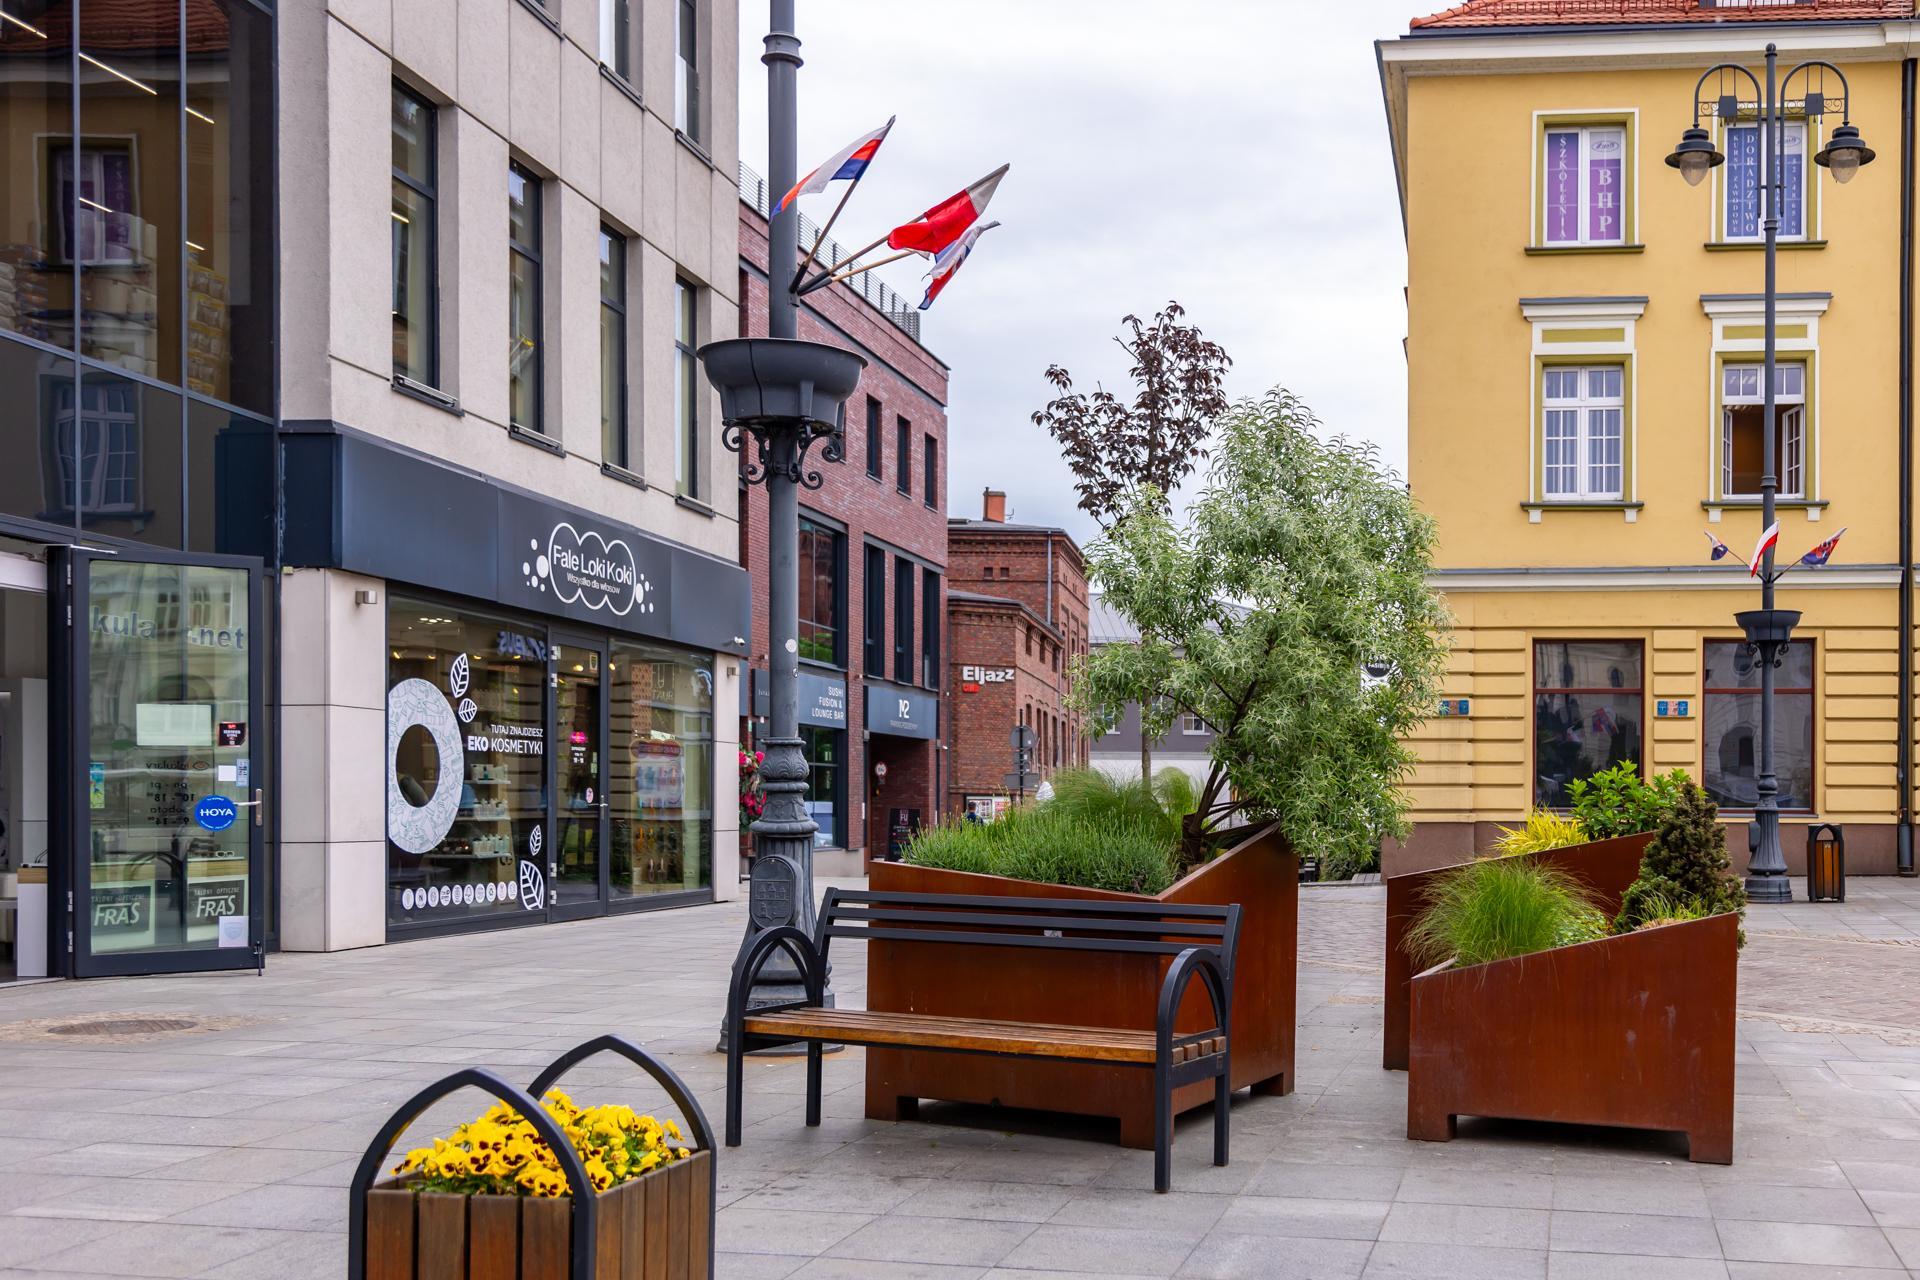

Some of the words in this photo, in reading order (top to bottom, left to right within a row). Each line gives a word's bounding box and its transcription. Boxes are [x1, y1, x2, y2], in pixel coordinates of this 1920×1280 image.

[1744, 134, 1756, 233] DORADZTWO
[1597, 168, 1614, 233] BHP
[553, 544, 580, 571] Fale
[580, 553, 606, 579] Loki
[606, 560, 632, 586] Koki
[566, 572, 591, 587] Wszystko
[591, 580, 600, 591] dla
[962, 666, 1015, 685] Eljazz
[828, 686, 844, 697] SUSHI
[818, 696, 838, 709] FUSION
[811, 707, 833, 719] LOUNGE
[833, 710, 845, 720] BAR
[491, 724, 509, 735] TUTAJ
[509, 726, 543, 738] ZNAJDZIESZ
[467, 735, 489, 752] EKO
[490, 737, 543, 755] KOSMETYKI
[200, 808, 234, 817] HOYA
[93, 902, 140, 926] FRAS
[195, 895, 236, 918] FRAS
